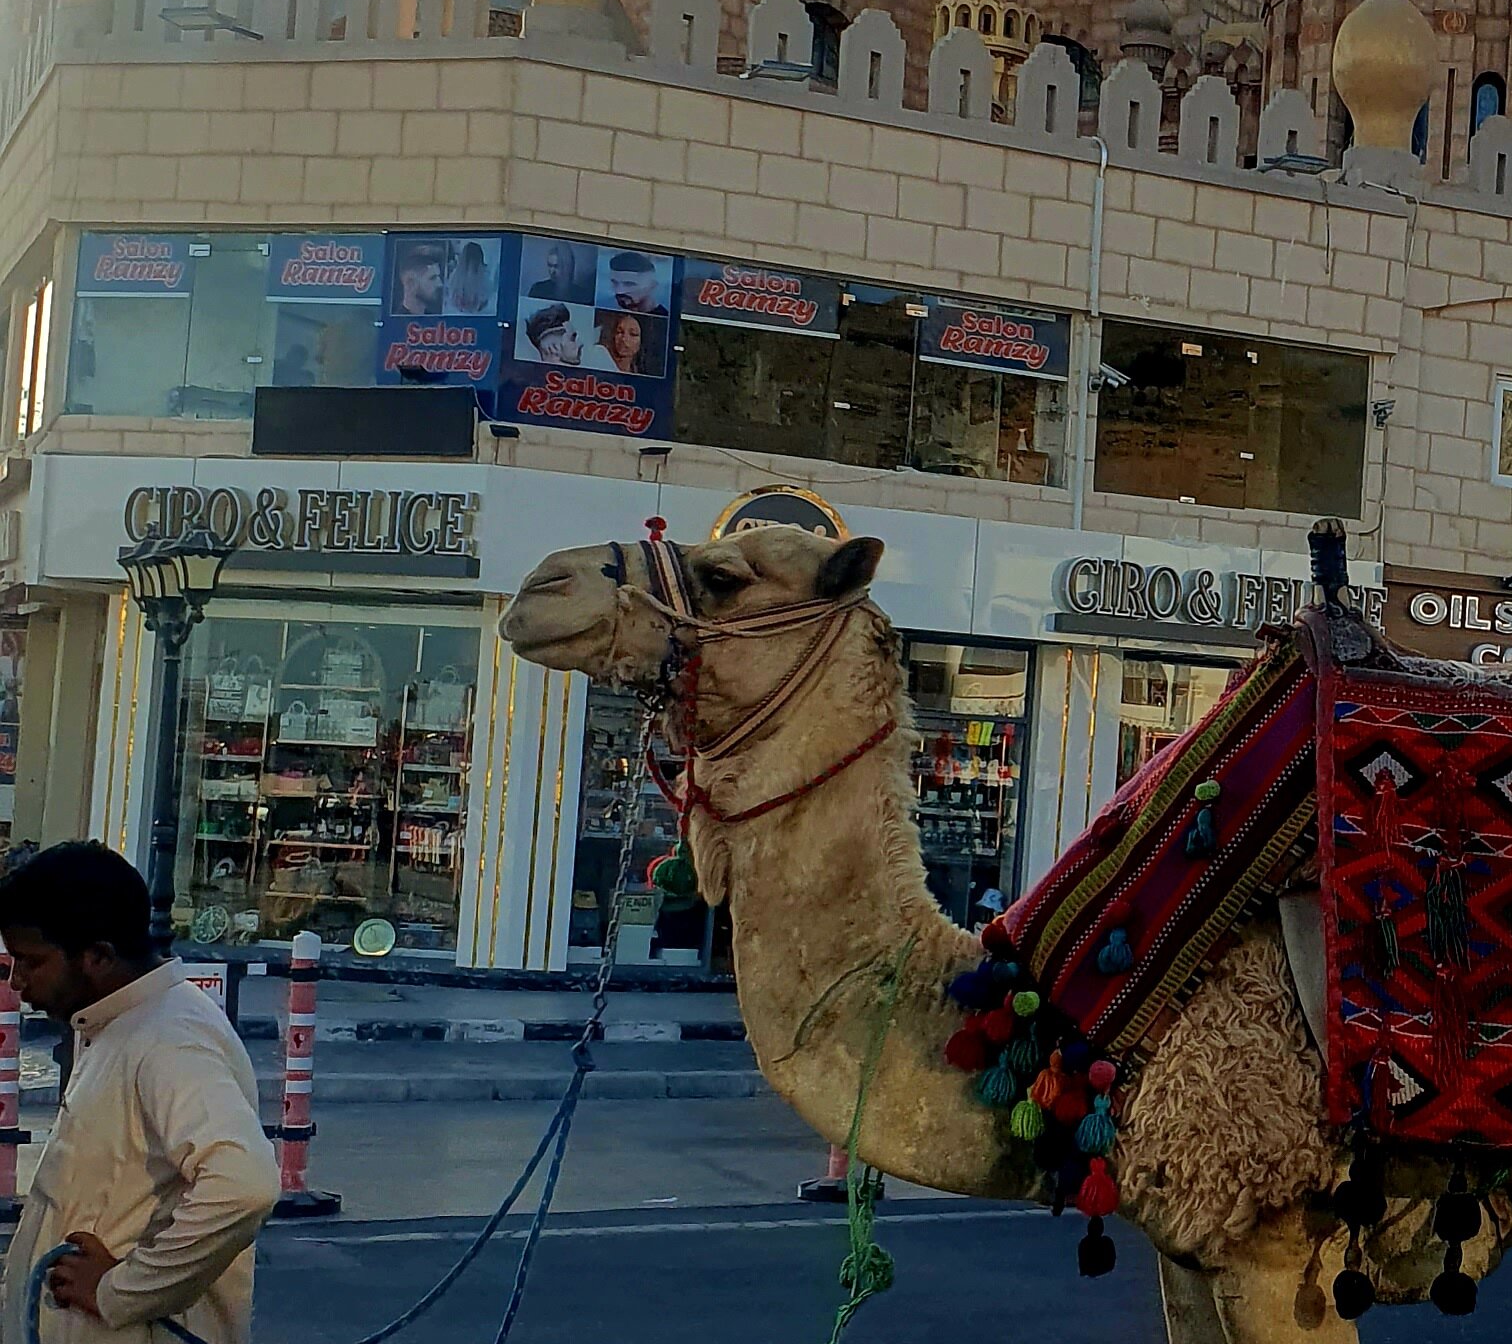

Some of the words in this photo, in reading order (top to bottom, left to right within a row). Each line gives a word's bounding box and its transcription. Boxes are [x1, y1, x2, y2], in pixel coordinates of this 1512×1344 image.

[113, 237, 172, 259] Salon
[301, 241, 363, 264] Salon
[95, 257, 184, 288] Ramzy
[281, 260, 375, 292] Ramzy
[722, 264, 801, 295] Salon
[698, 278, 818, 326] Ramzy
[407, 321, 477, 346] Salon
[962, 311, 1034, 340] Salon
[384, 343, 492, 381] Ramzy
[940, 326, 1049, 369] Ramzy
[546, 371, 637, 402] Salon
[517, 385, 655, 434] Ramzy
[294, 488, 475, 555] FELICE
[1064, 555, 1184, 621] CIRO
